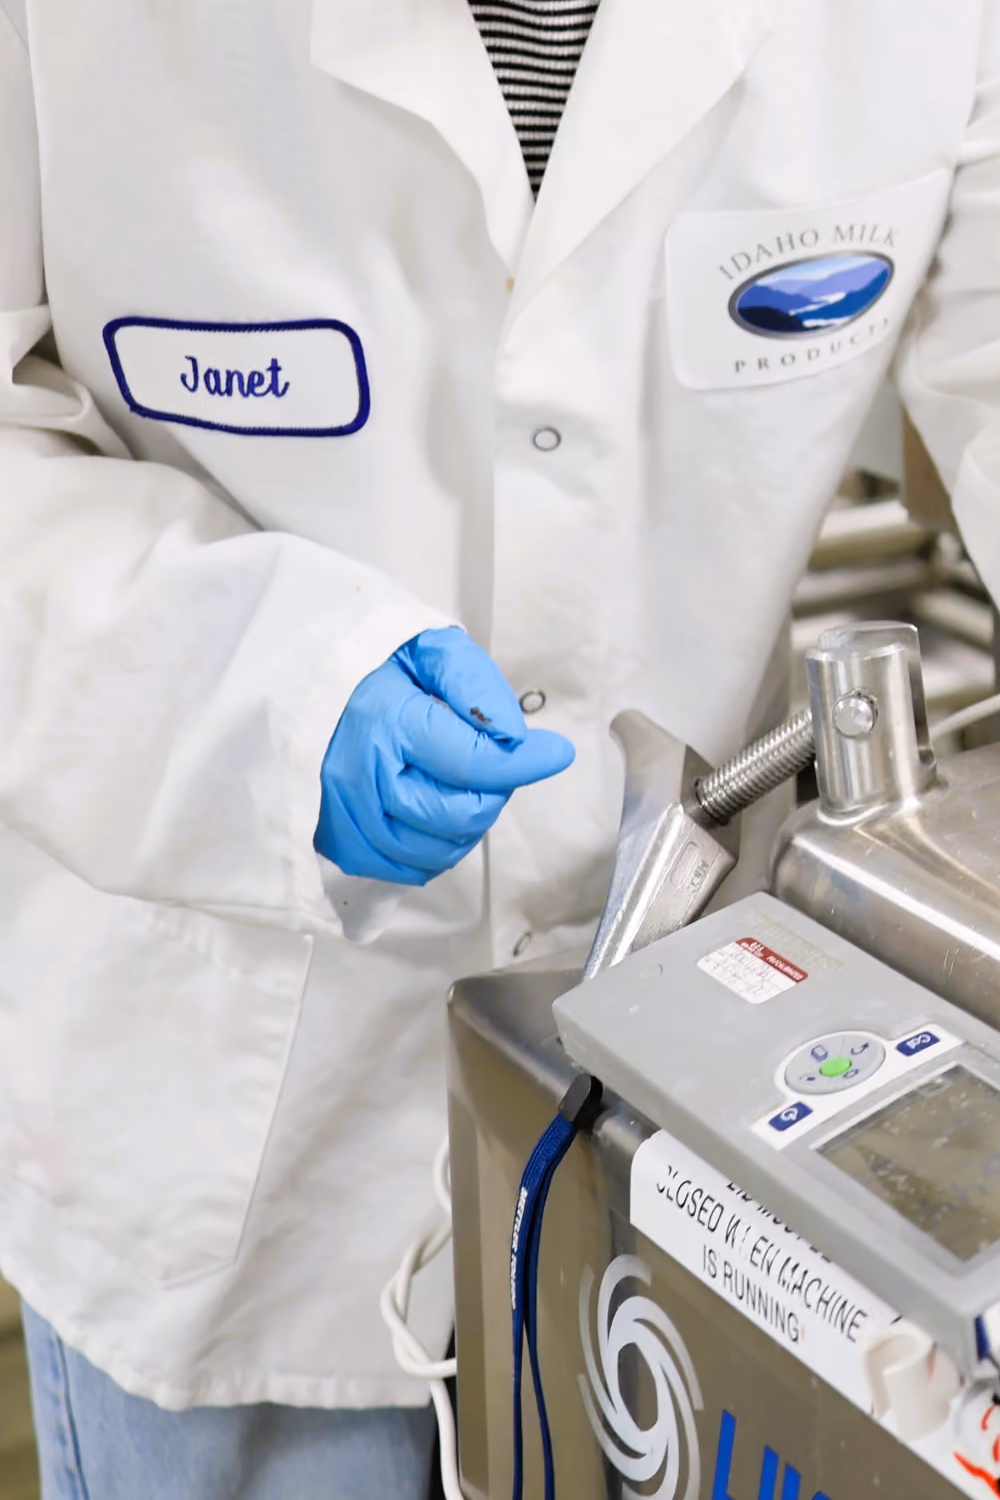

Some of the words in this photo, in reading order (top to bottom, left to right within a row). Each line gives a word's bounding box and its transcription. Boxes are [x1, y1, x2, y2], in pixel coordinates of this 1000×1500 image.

[718, 227, 820, 280] IDAHO
[832, 223, 899, 248] MILK
[180, 355, 290, 398] Janet
[703, 1243, 718, 1279] IS
[722, 1260, 800, 1345] RUNNING
[777, 1256, 869, 1344] MACHINE
